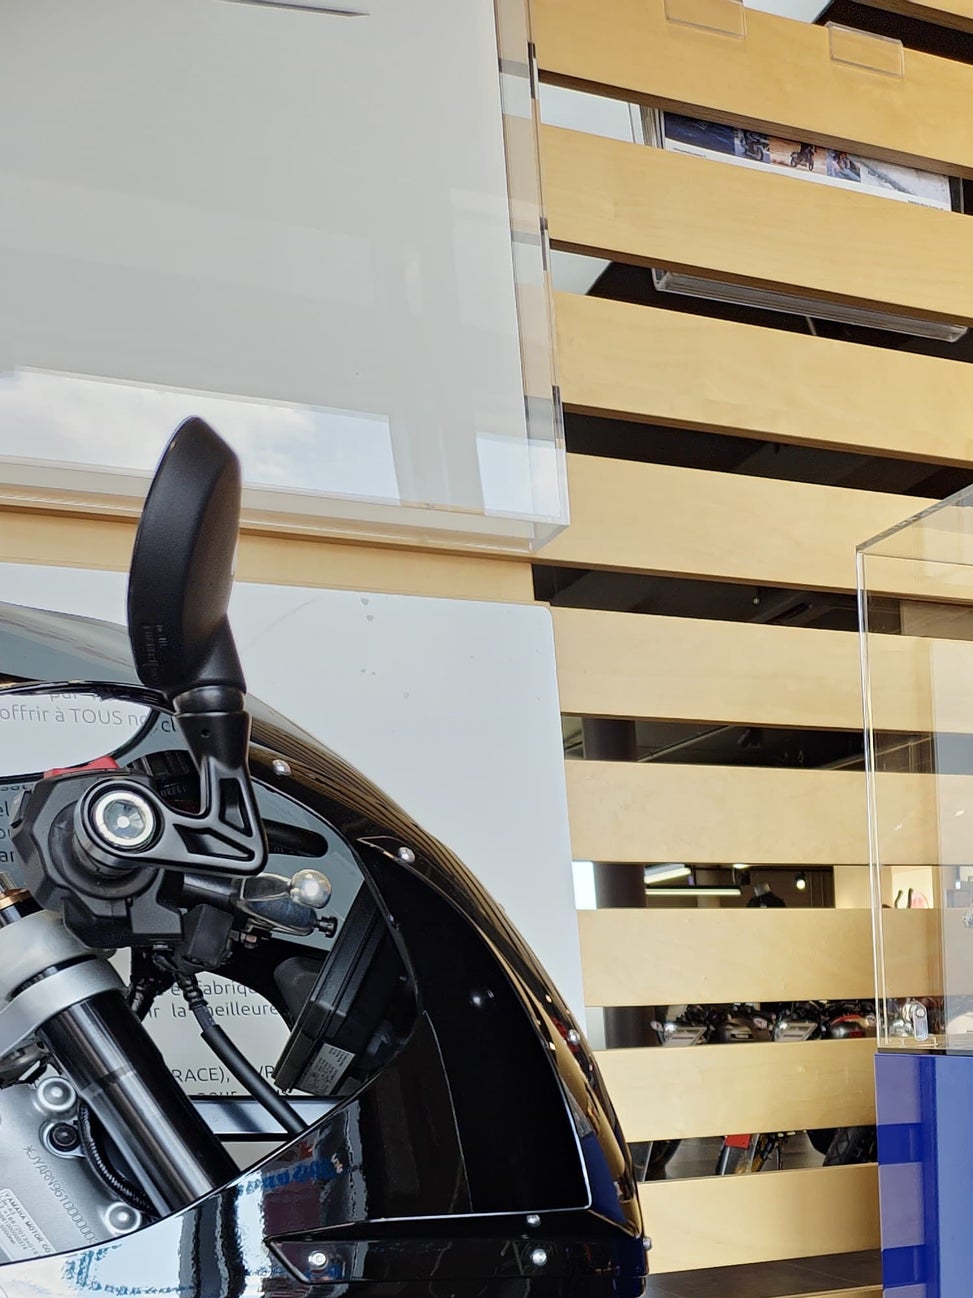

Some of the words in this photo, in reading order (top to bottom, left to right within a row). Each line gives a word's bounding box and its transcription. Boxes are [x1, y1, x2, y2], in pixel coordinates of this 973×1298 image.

[55, 706, 65, 723] à
[70, 709, 122, 725] TOUS
[171, 1003, 187, 1018] la
